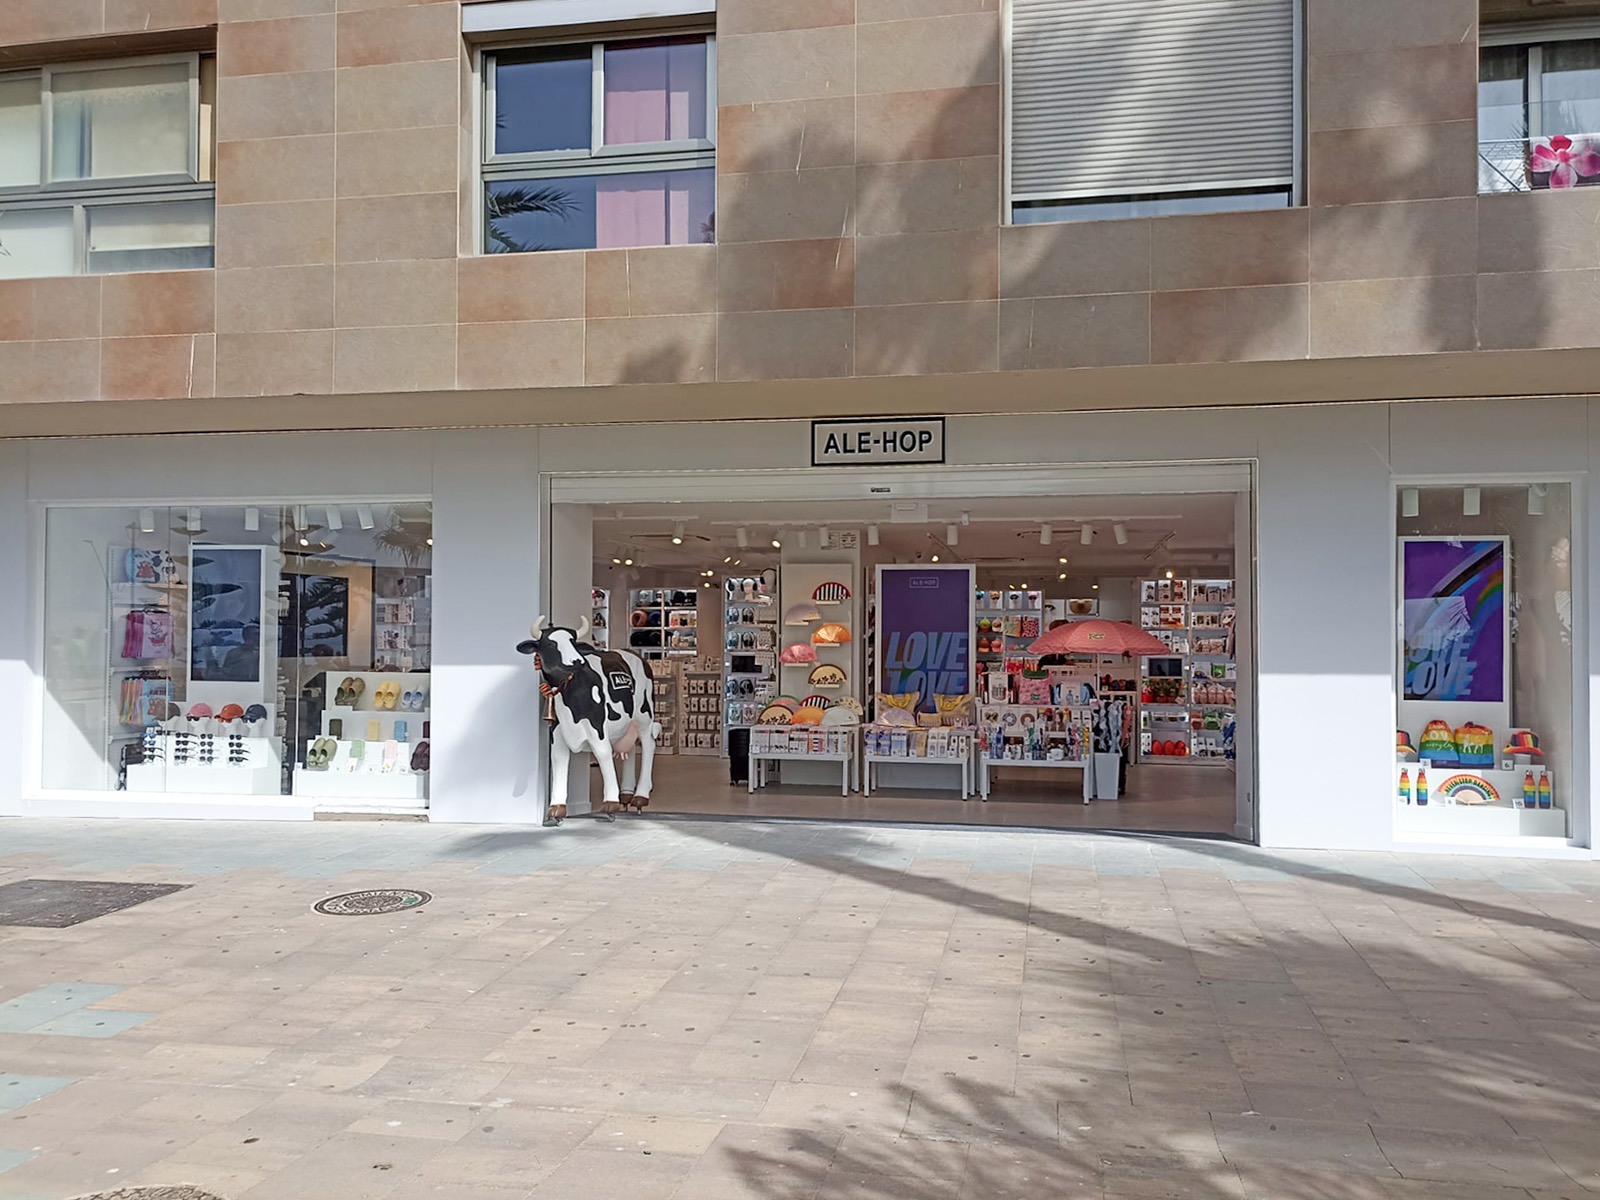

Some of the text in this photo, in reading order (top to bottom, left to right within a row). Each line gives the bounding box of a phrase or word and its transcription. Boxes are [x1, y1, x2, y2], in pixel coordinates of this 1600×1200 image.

[823, 430, 933, 454] ALE-HOP
[885, 631, 969, 669] LOVE
[1404, 629, 1474, 662] OVE
